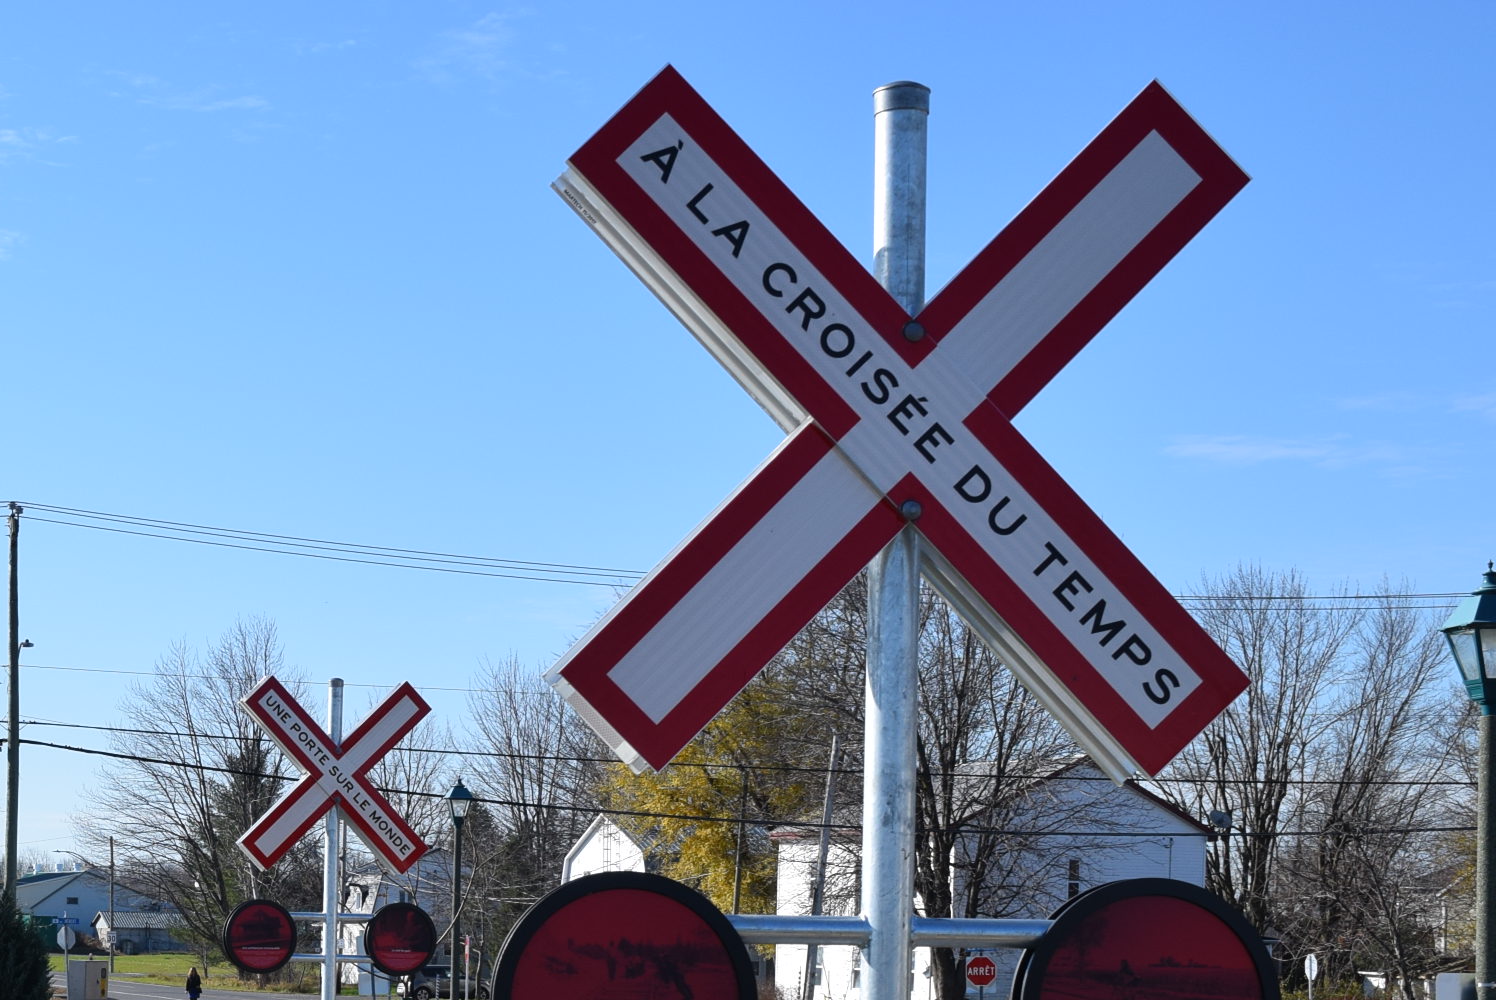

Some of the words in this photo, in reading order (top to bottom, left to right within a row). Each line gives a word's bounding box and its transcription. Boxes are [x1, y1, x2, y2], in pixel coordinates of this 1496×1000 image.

[640, 140, 684, 184] À
[687, 184, 750, 258] LA
[763, 263, 954, 464] CROISÉE
[954, 465, 1027, 536] DU
[1033, 542, 1181, 705] TEMPS
[266, 696, 291, 723] UNE
[290, 723, 329, 765] PORTE
[329, 765, 354, 793] SUR
[353, 792, 370, 811] LE
[369, 811, 410, 855] MONDE
[968, 965, 994, 975] ARRÊT
